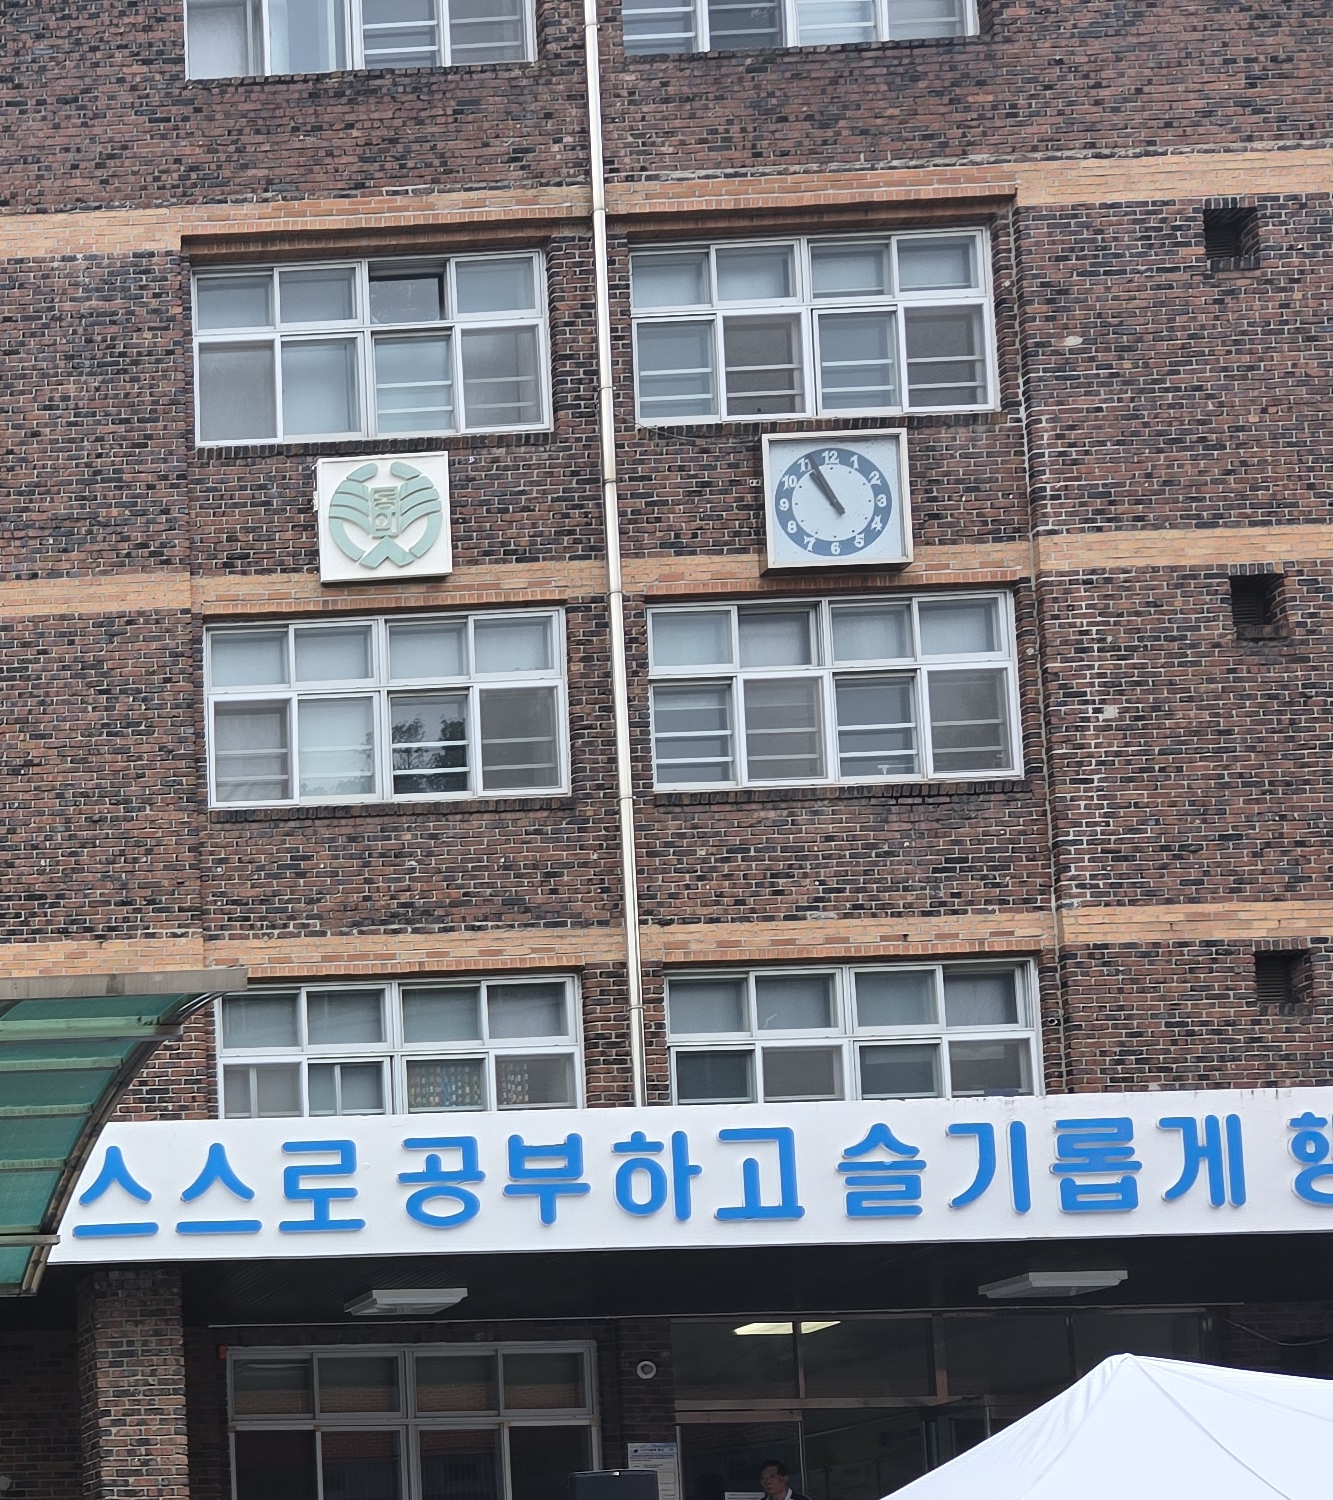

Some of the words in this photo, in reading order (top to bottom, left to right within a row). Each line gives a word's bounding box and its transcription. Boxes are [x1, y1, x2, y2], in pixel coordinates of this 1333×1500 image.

[822, 450, 839, 465] 12
[850, 455, 860, 469] 1
[869, 471, 882, 486] 2
[779, 498, 790, 512] 9
[876, 494, 887, 508] 3
[787, 520, 798, 534] 8
[871, 514, 883, 533] 4
[803, 535, 817, 552] 7
[854, 533, 865, 548] 5
[830, 542, 841, 555] 6
[73, 1139, 366, 1239] 스스로
[397, 1127, 806, 1229] 공부하고
[837, 1113, 1247, 1218] 슬기롭게
